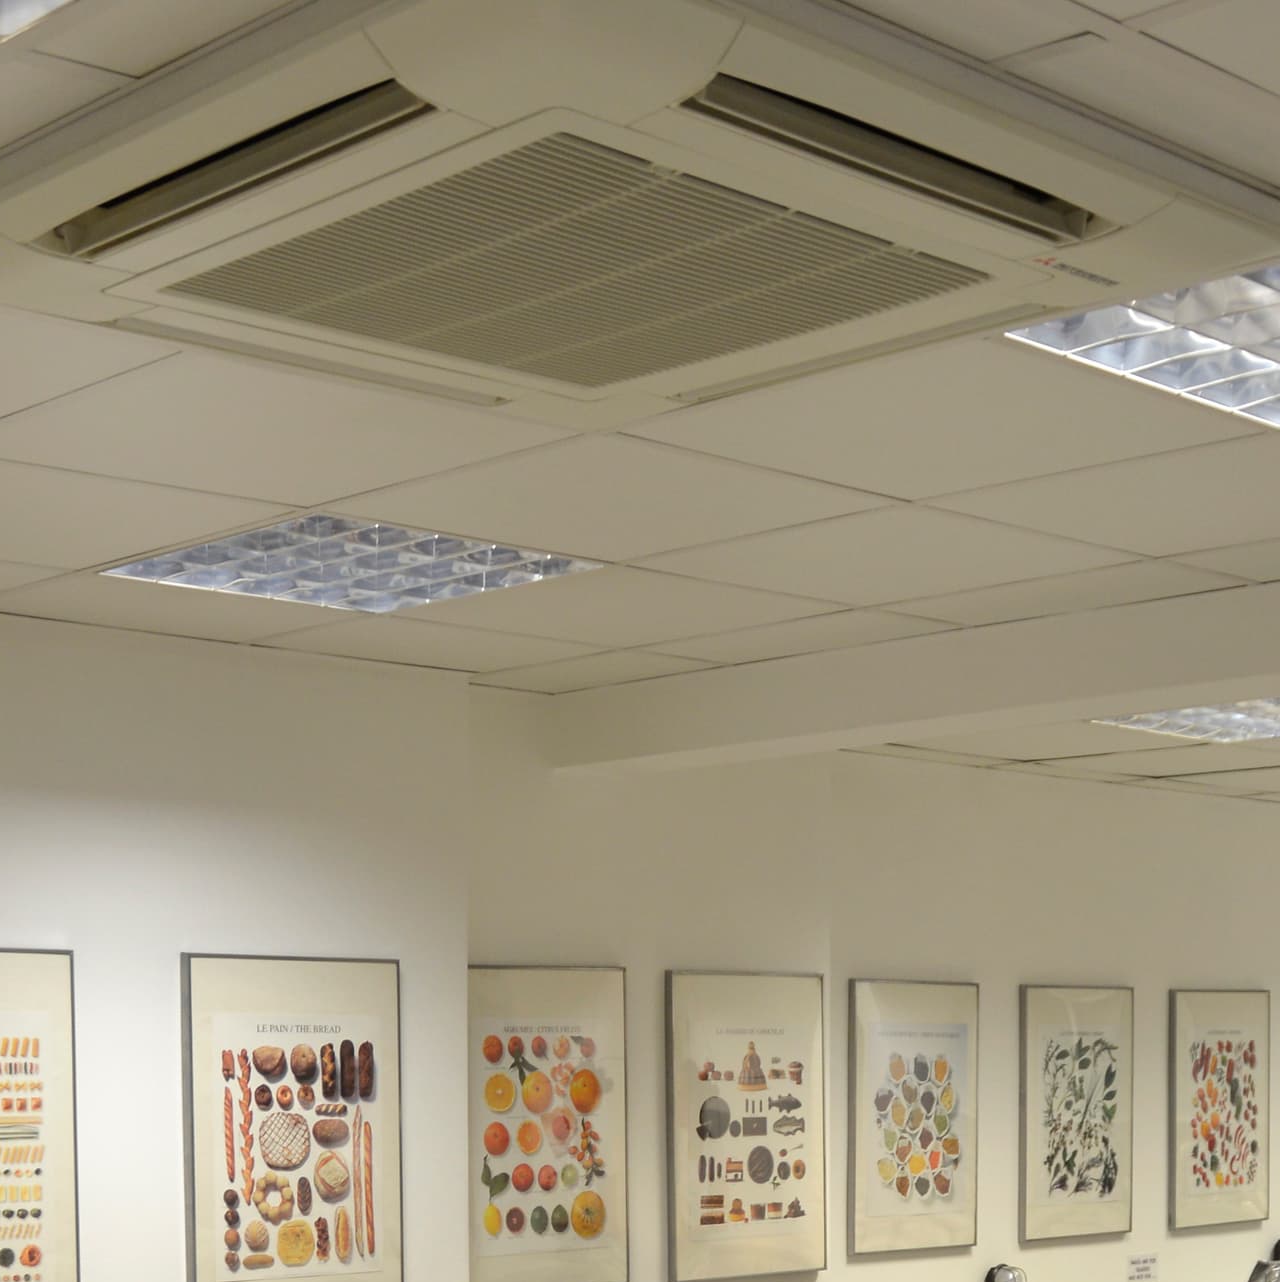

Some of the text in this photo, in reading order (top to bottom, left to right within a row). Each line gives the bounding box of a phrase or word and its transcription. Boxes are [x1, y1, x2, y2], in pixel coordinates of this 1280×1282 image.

[256, 1024, 268, 1033] LE
[269, 1024, 288, 1033] PAIN
[295, 1024, 312, 1033] THE
[313, 1024, 342, 1034] BREAD
